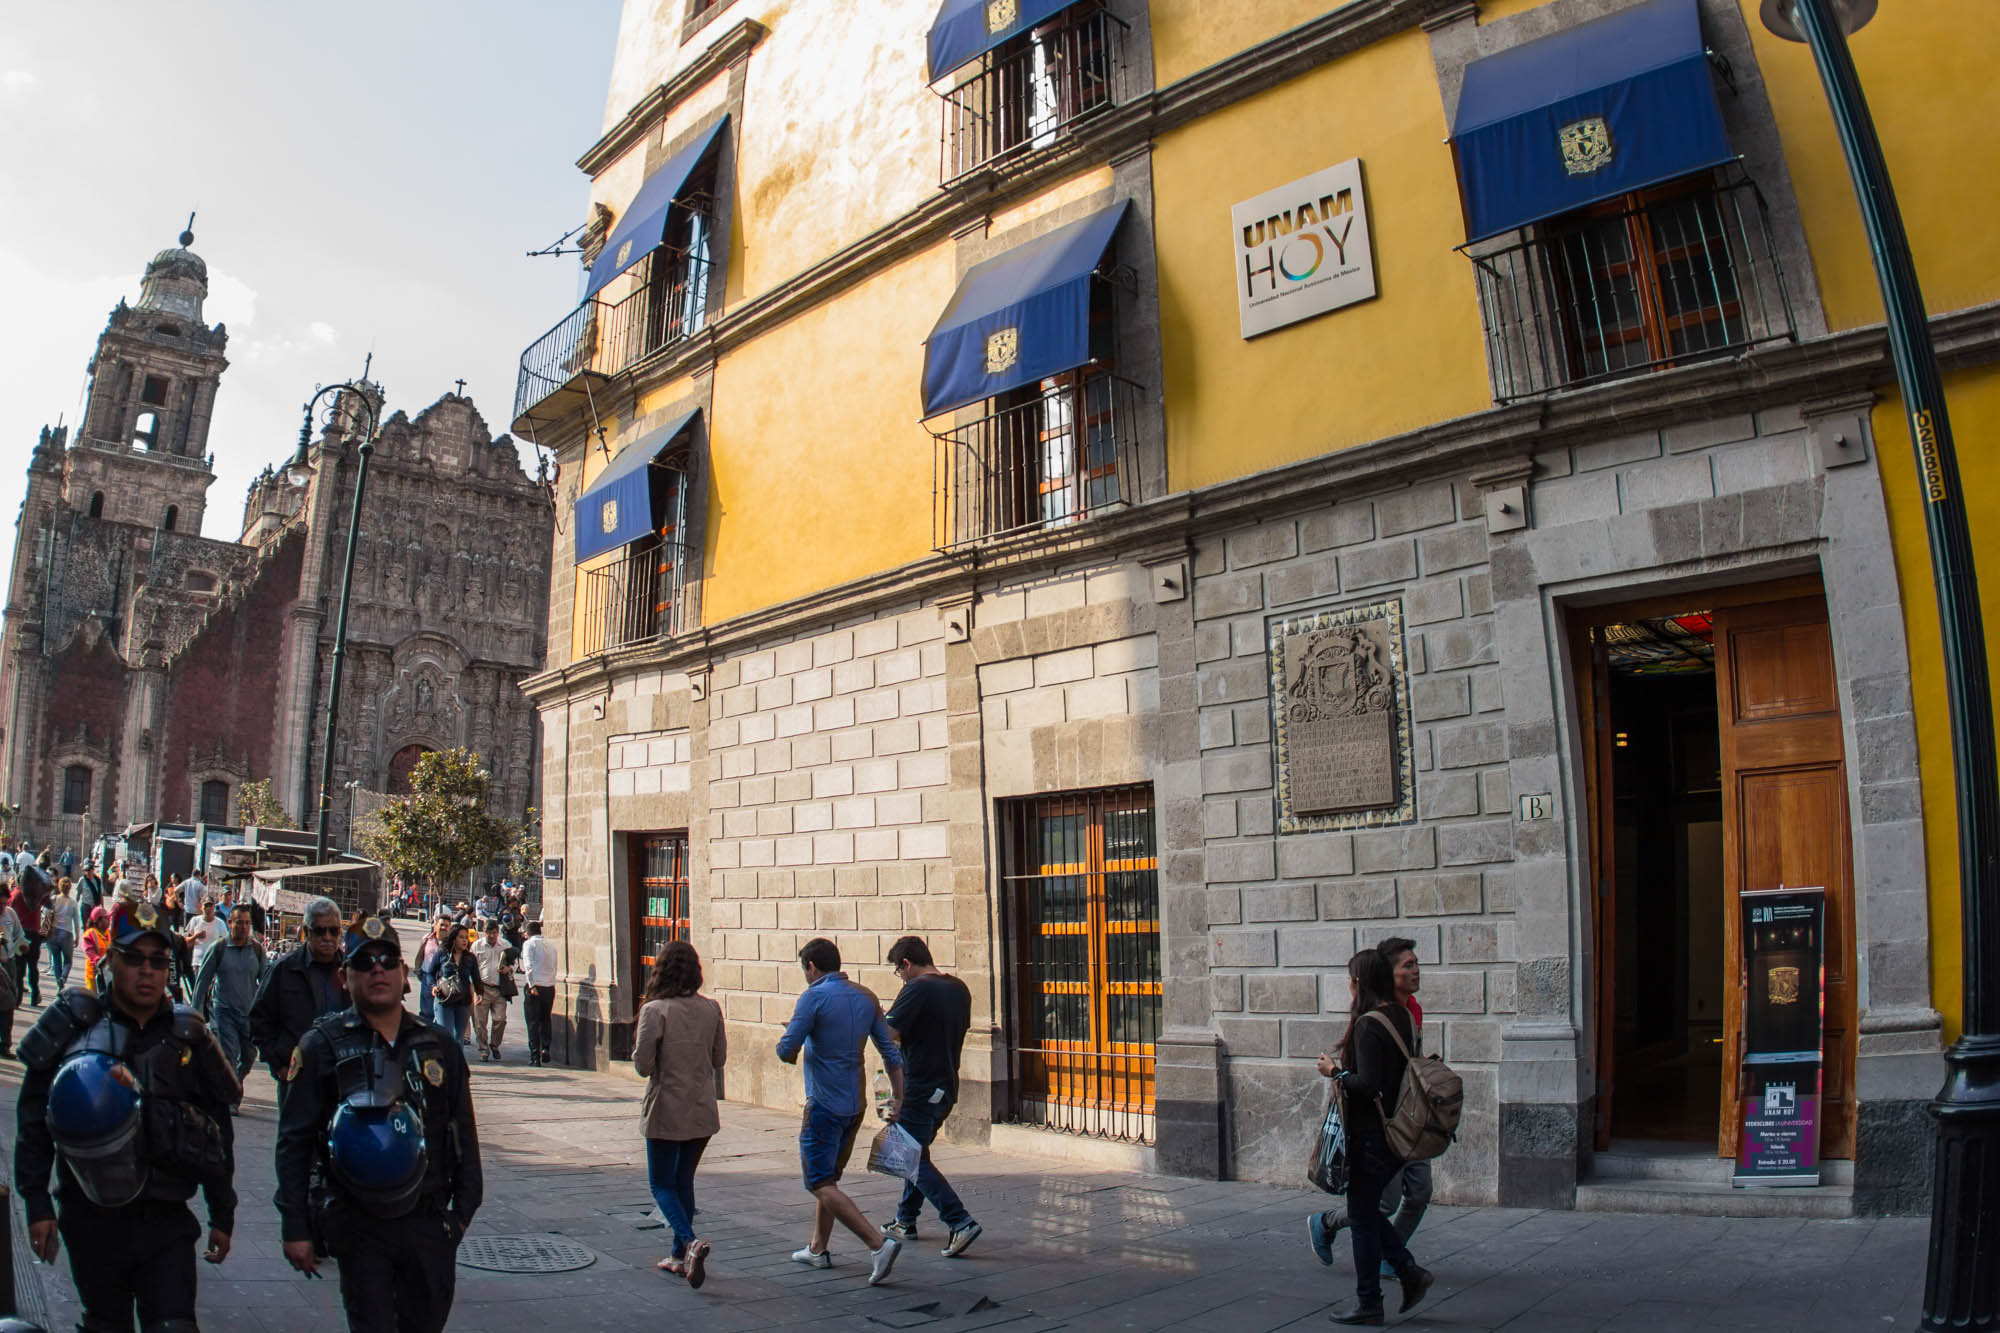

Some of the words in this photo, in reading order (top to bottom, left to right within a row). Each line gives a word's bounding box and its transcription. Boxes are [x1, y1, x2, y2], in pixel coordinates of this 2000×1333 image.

[1243, 187, 1353, 249] UNAM
[1245, 215, 1354, 298] HOY
[1917, 413, 1942, 499] 028866
[1530, 797, 1543, 818] B
